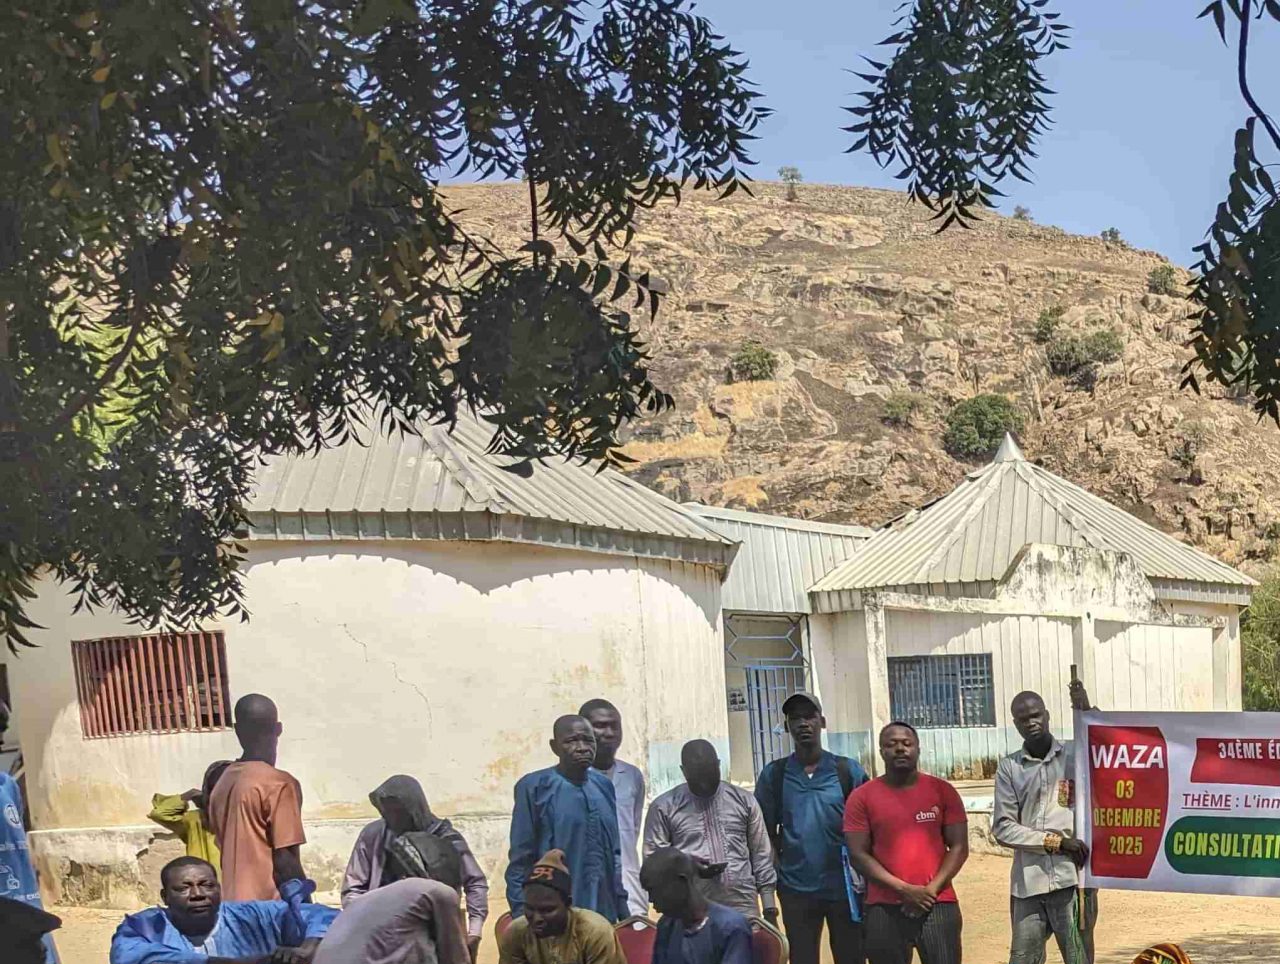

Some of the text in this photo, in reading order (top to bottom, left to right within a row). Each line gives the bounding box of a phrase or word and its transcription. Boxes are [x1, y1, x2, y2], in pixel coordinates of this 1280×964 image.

[1091, 745, 1164, 769] WAZA
[1218, 740, 1263, 760] 34ÈME
[1116, 780, 1134, 799] 03
[1182, 791, 1232, 808] THÈME
[915, 811, 936, 820] cbm
[1093, 807, 1161, 828] DECEMBRE
[1109, 836, 1143, 855] 2025
